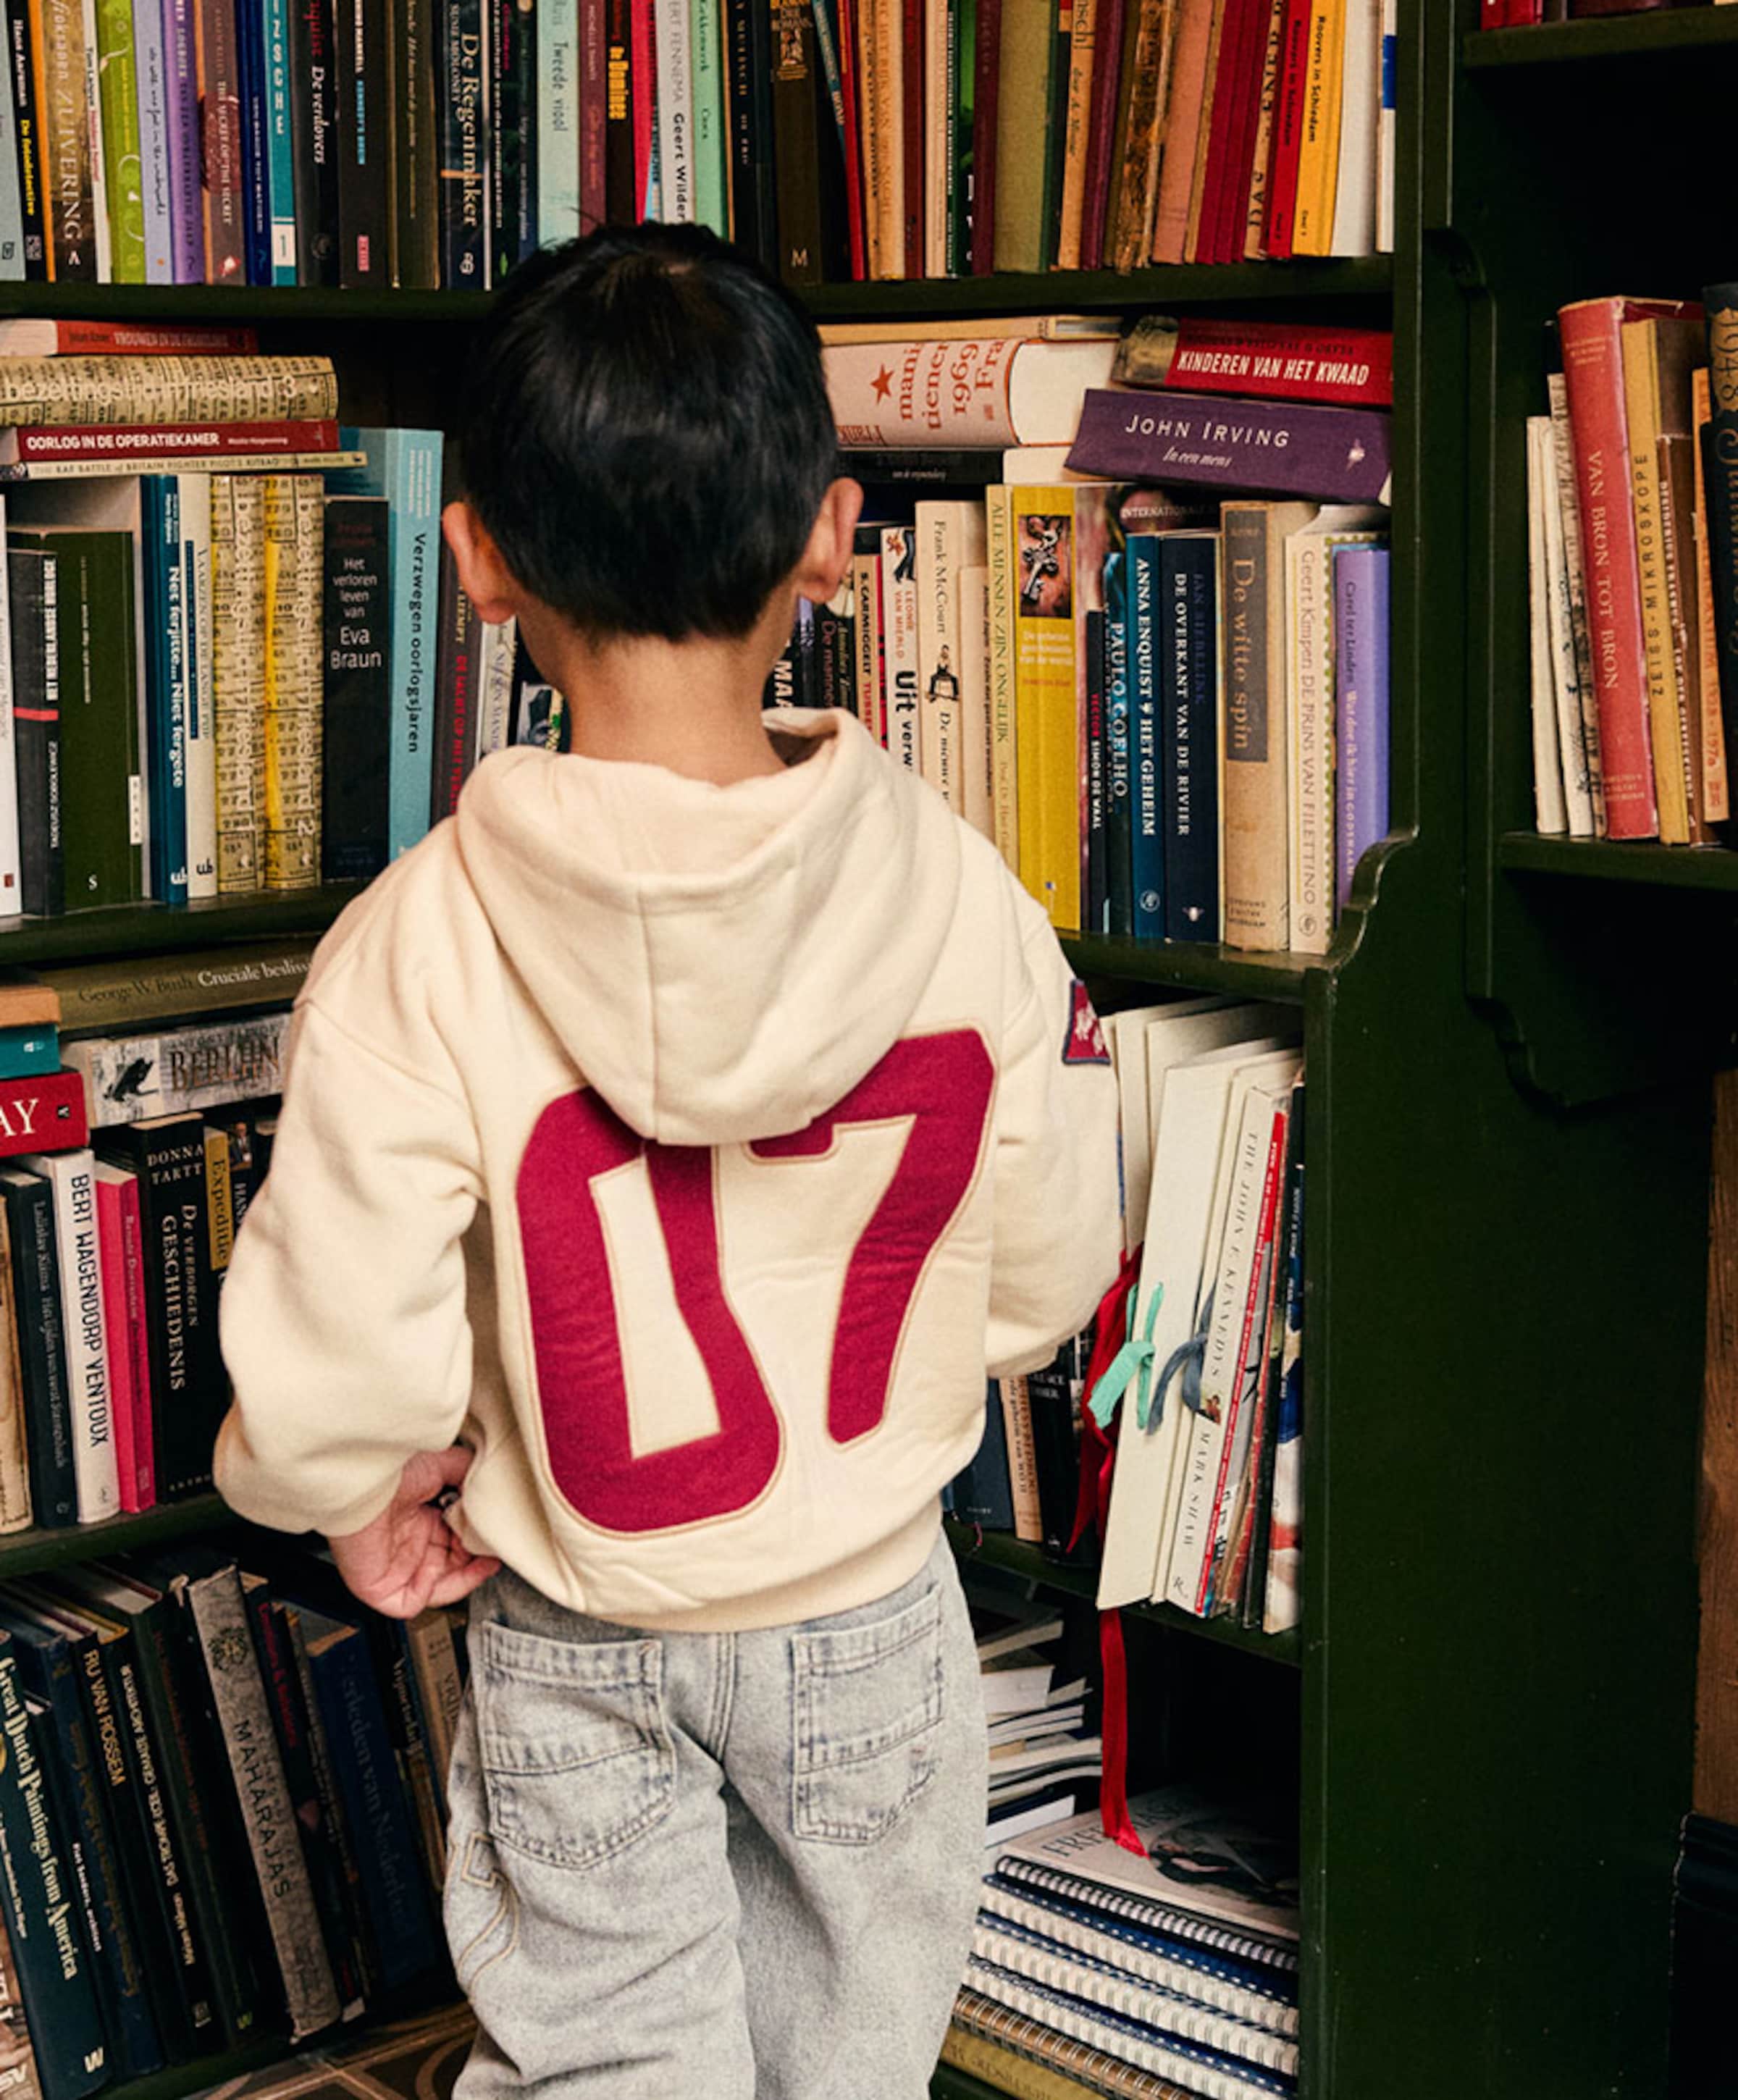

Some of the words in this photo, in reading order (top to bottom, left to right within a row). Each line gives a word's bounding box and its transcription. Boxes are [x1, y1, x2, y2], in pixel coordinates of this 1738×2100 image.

[460, 33, 479, 70] De
[311, 67, 325, 90] De
[673, 112, 685, 159] Geert
[56, 89, 82, 240] ZUIVERING
[675, 166, 687, 222] Wilder
[950, 343, 979, 416] 1969
[1177, 350, 1250, 377] KINDEREN
[1253, 356, 1282, 379] VAN
[1285, 358, 1313, 382] HET
[1317, 361, 1369, 387] KWAAD
[27, 435, 81, 450] OORLOG
[83, 434, 95, 449] IN
[97, 434, 114, 449] DE
[116, 432, 219, 448] OPERATIEKAMER
[1126, 415, 1190, 439] JOHN
[1201, 421, 1290, 448] IRVING
[1587, 450, 1604, 496] VAN
[934, 521, 946, 561] Frank
[992, 504, 1007, 542] ALLE
[1591, 506, 1608, 567] BRON
[168, 566, 181, 600] Net
[343, 557, 365, 571] Het
[408, 533, 428, 632] Verzwegen
[1135, 558, 1151, 612] ANNA
[1174, 573, 1188, 597] DE
[1232, 557, 1256, 602] De
[1301, 550, 1317, 603] Geert
[935, 566, 948, 634] McCourt
[1596, 576, 1613, 618] TOT
[340, 626, 371, 645] Eva
[995, 623, 1007, 661] ZIJN
[1136, 616, 1153, 698] ENQUIST
[1175, 602, 1188, 699] OVERKANT
[1233, 612, 1253, 684] witte
[1600, 629, 1619, 689] BRON
[331, 650, 382, 671] Braun
[1110, 623, 1127, 697] PAULO
[171, 682, 182, 714] Niet
[405, 638, 424, 752] oorlogsjaren
[895, 671, 917, 713] Uit
[996, 664, 1009, 744] ONGELIJK
[1301, 675, 1316, 698] DE
[939, 711, 951, 731] De
[1140, 718, 1154, 754] HET
[1176, 704, 1188, 739] VAN
[1229, 692, 1253, 749] spin
[1301, 703, 1317, 752] PRINS
[1091, 740, 1101, 778] SIMON
[1111, 702, 1128, 799] COELHO
[1176, 745, 1189, 770] DE
[1092, 780, 1101, 795] DE
[1141, 759, 1156, 835] GEHEIM
[1301, 757, 1316, 794] VAN
[1092, 797, 1101, 829] WAAL
[1176, 775, 1190, 836] RIVIER
[1302, 802, 1317, 904] FILETTINO
[79, 983, 132, 1002] George
[197, 965, 261, 987] Cruciale
[147, 1143, 203, 1167] DONNA
[151, 1162, 203, 1185] TARTT
[1243, 1131, 1259, 1171] THE
[71, 1174, 94, 1222] BERT
[181, 1204, 198, 1230] De
[1234, 1180, 1251, 1234] JOHN
[76, 1231, 103, 1352] WAGENDORP
[161, 1214, 185, 1390] GESCHIEDENIS
[1212, 1269, 1237, 1377] KENNEDYS
[86, 1361, 109, 1448] VENTOUX
[1193, 1432, 1211, 1483] MARK
[1183, 1495, 1198, 1546] SHAW
[0, 1656, 28, 1715] Great
[83, 1649, 103, 1677] RU
[89, 1677, 112, 1715] VAN
[4, 1712, 38, 1773] Dutch
[98, 1715, 127, 1787] ROSSEM
[17, 1769, 54, 1858] Paintings
[234, 1718, 291, 1899] MAHARAJAS
[39, 1860, 61, 1902] from
[46, 1904, 79, 1980] America
